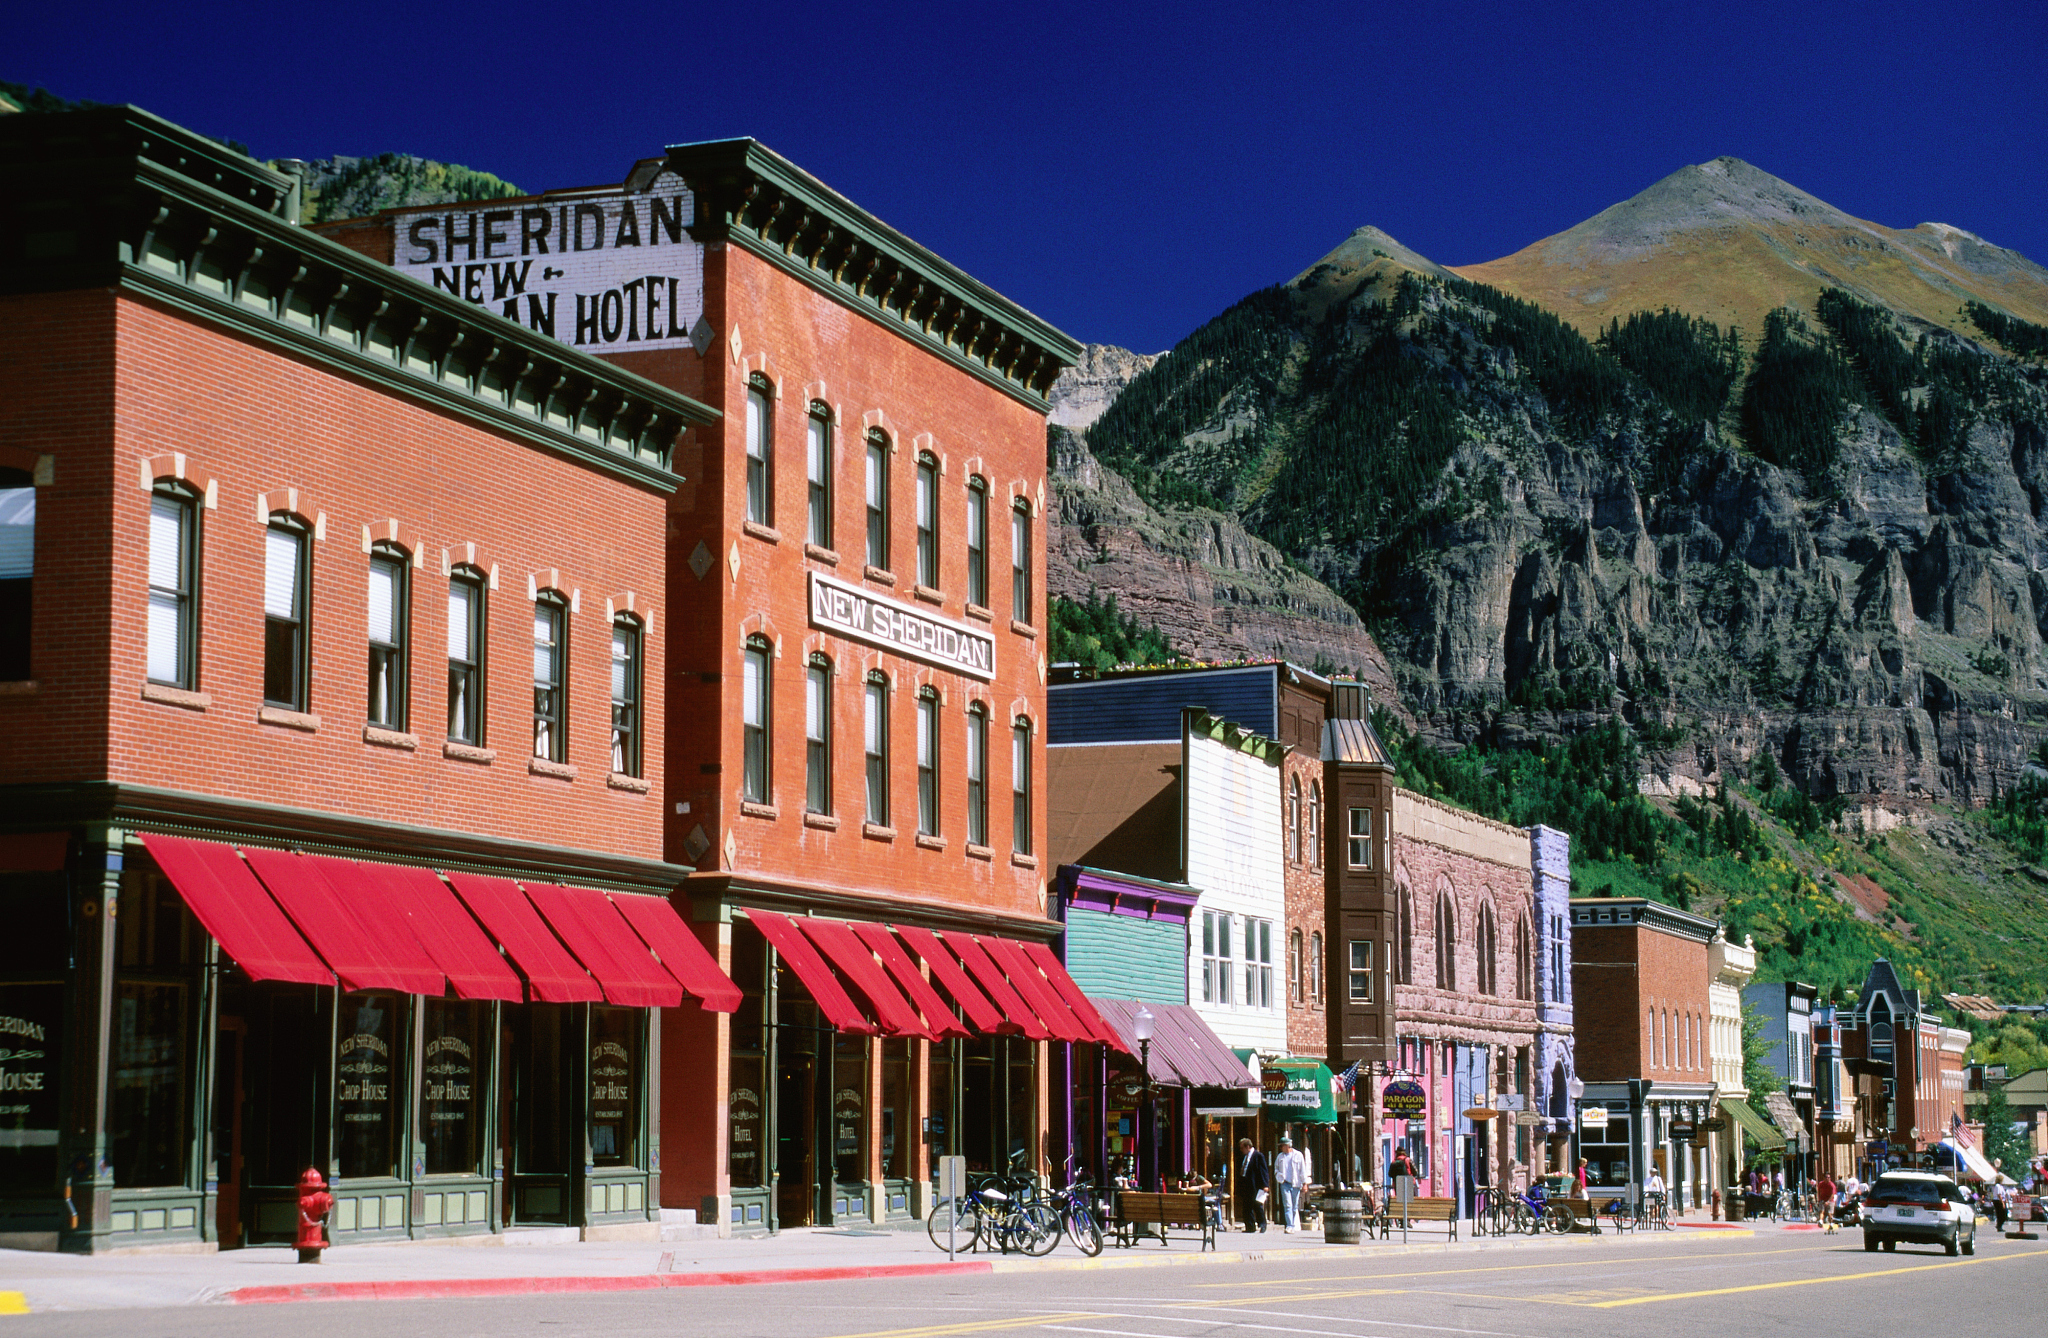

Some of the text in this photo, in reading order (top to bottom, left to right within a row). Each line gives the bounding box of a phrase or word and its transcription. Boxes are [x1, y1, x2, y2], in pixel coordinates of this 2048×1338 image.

[408, 197, 682, 264] SHERIDAN
[432, 259, 534, 304] NEW
[574, 275, 689, 345] HOTEL
[815, 583, 868, 630] NEW
[340, 1033, 388, 1059] NEW SHERIDAN
[426, 1035, 471, 1060] NEW SHERIDAN
[603, 1041, 628, 1063] SHERIDAN
[1269, 1093, 1287, 1101] AZADI
[1288, 1094, 1300, 1102] Fine
[1302, 1094, 1315, 1102] Rugs
[734, 1125, 753, 1142] HOTEL
